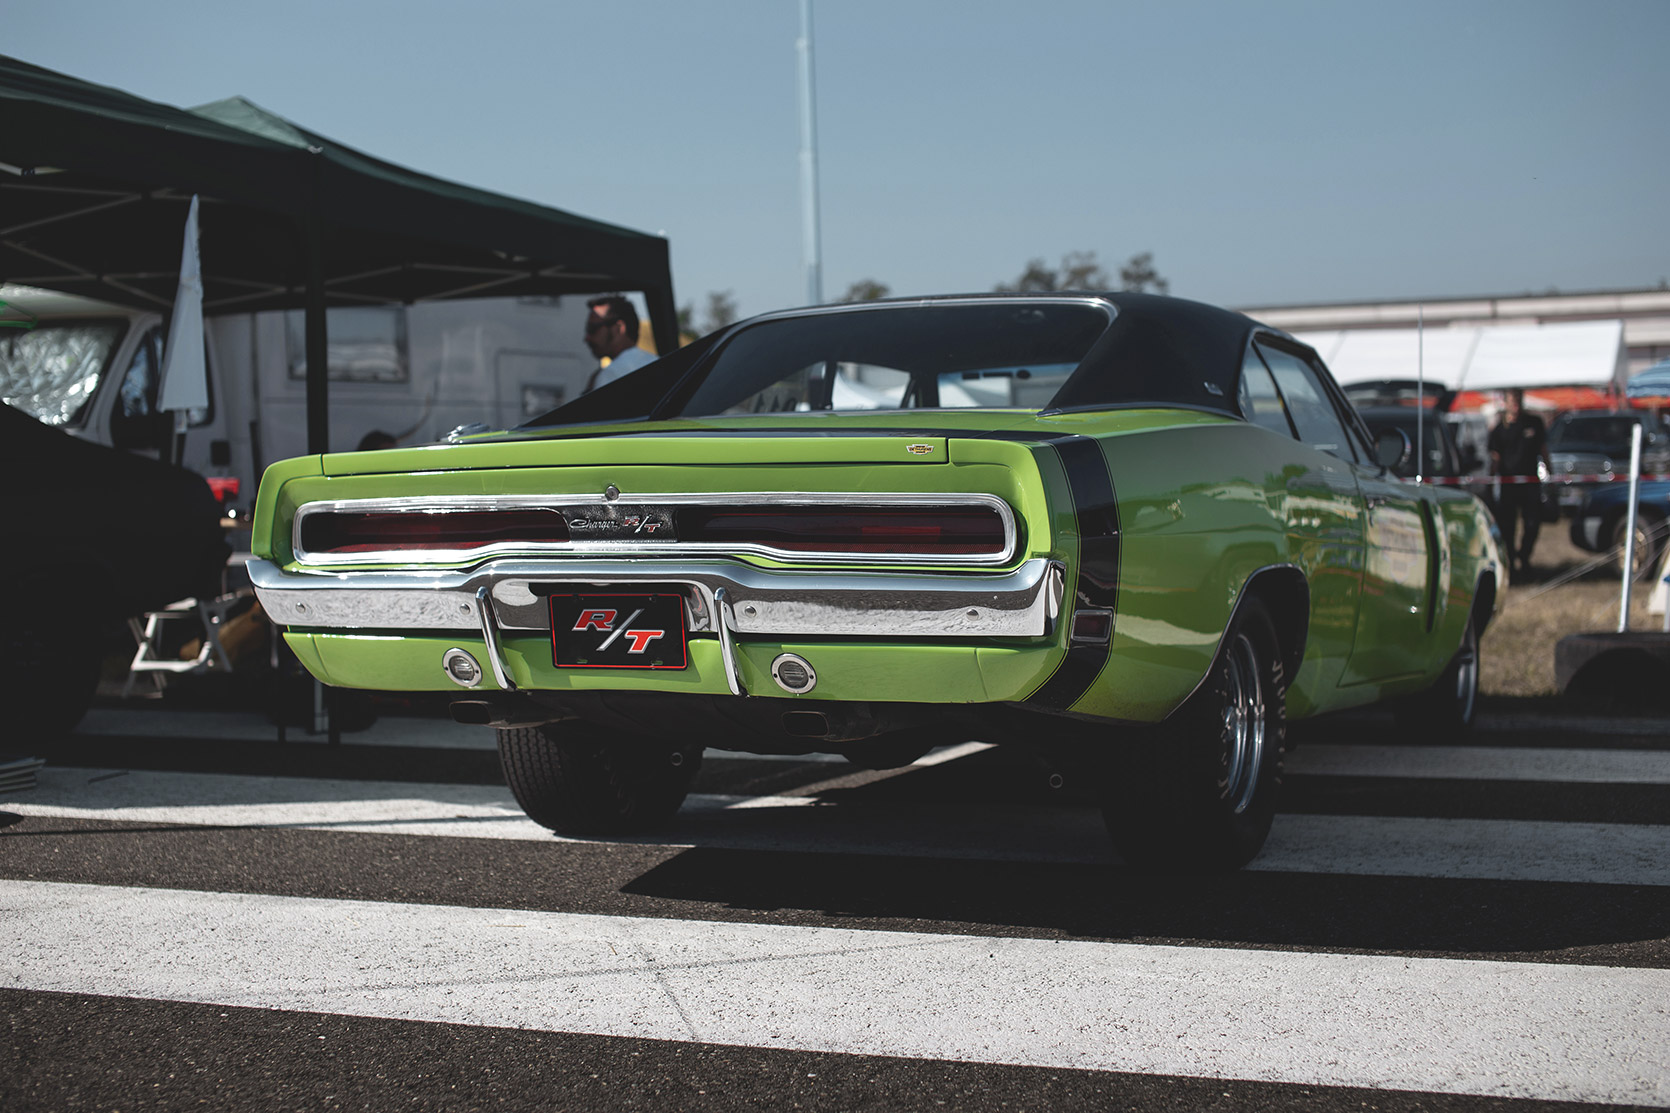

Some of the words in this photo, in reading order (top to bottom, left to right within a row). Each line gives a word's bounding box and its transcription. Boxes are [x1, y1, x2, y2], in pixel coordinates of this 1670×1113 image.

[569, 517, 618, 530] Charger
[623, 514, 662, 533] R/T
[571, 608, 665, 654] R/T
